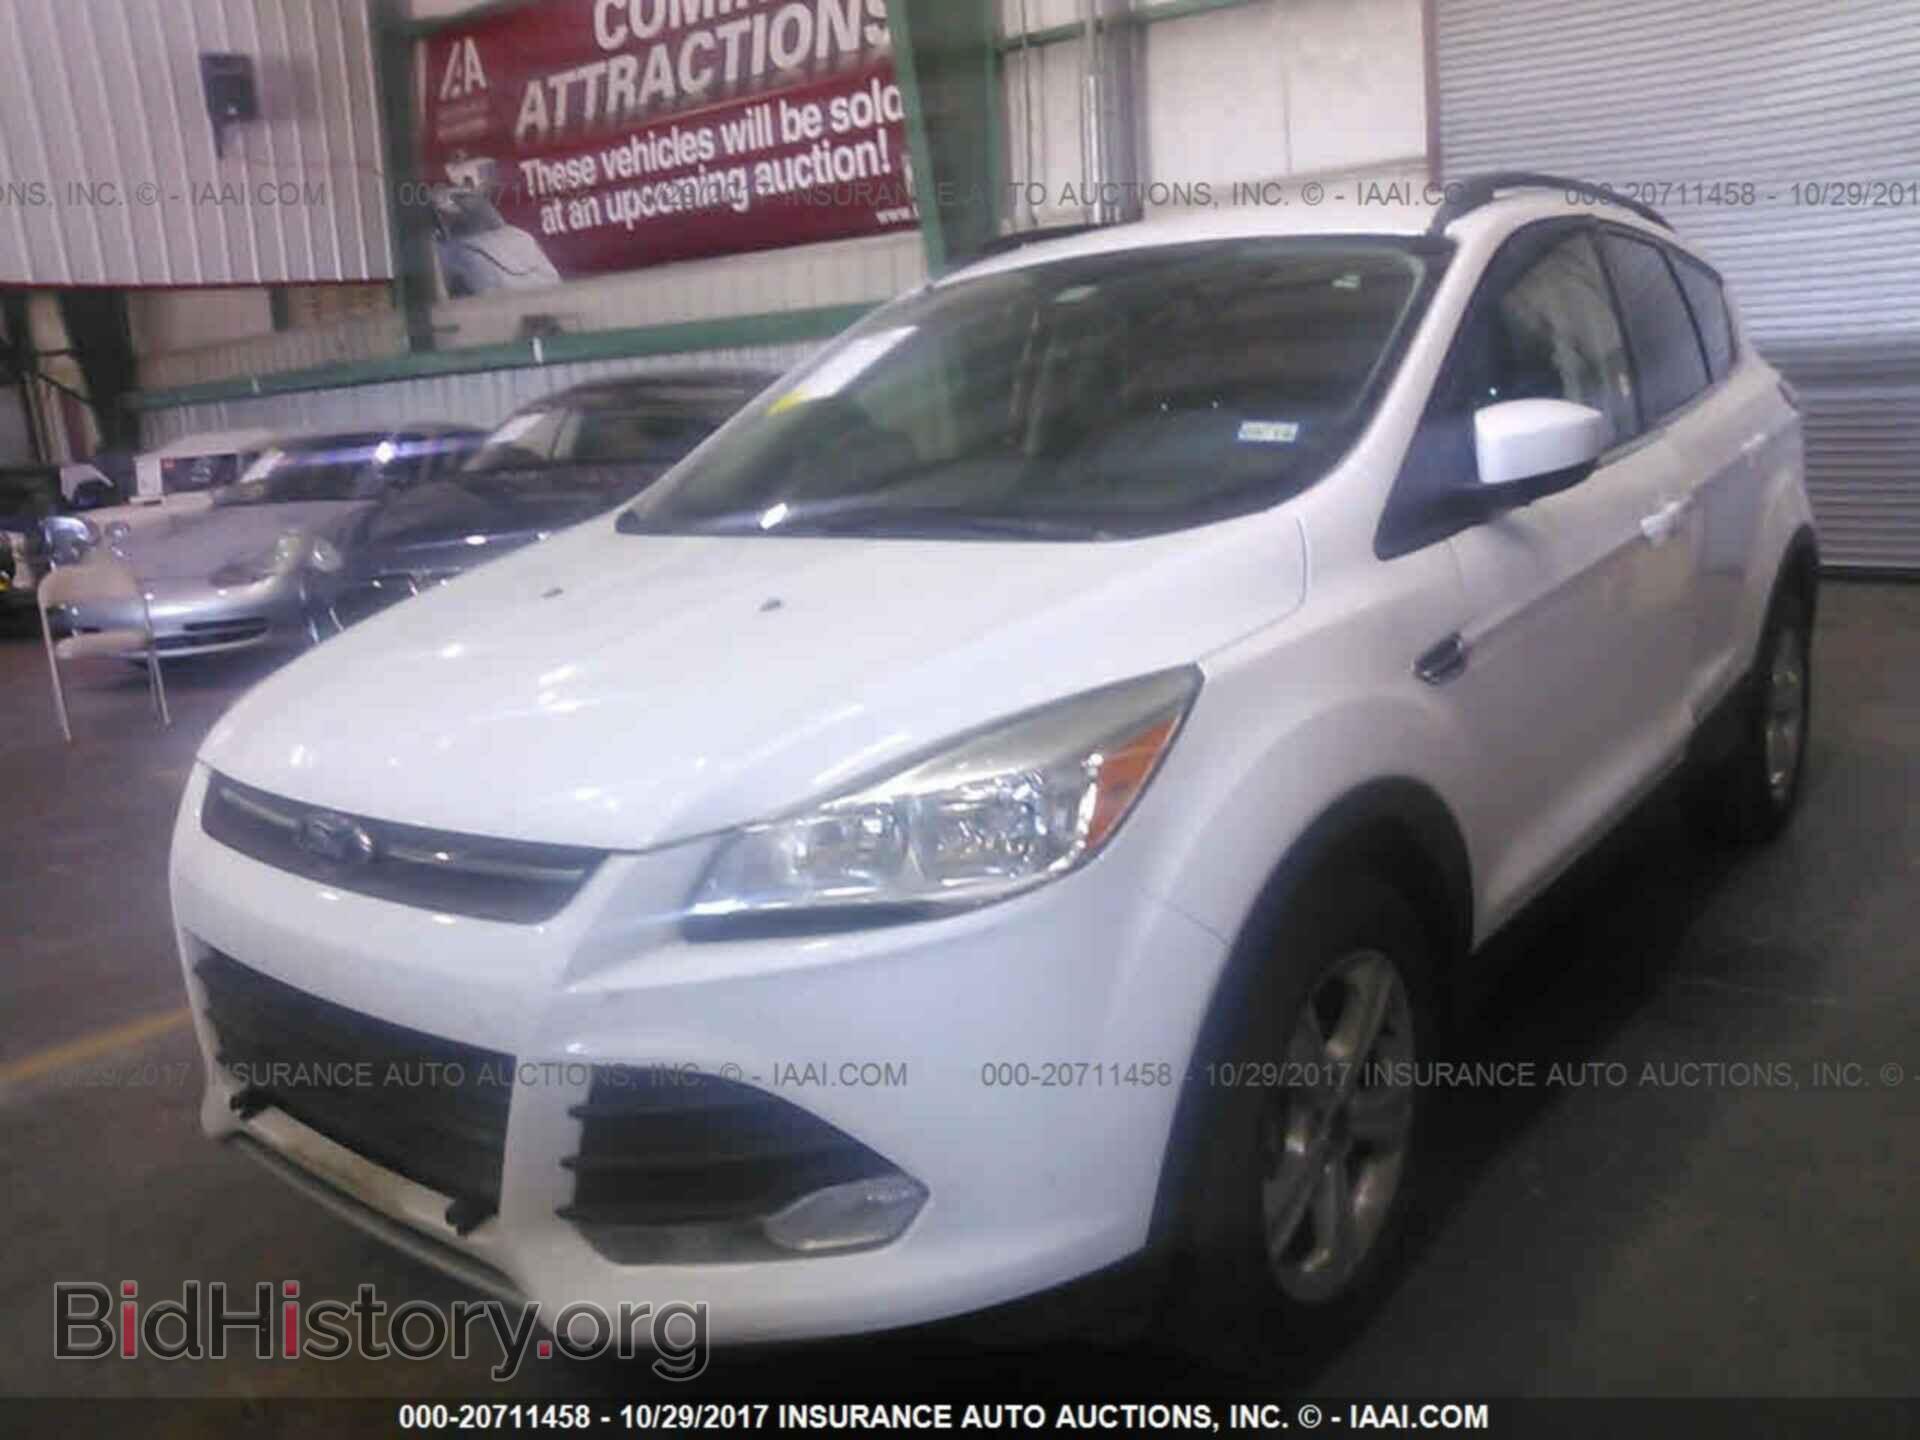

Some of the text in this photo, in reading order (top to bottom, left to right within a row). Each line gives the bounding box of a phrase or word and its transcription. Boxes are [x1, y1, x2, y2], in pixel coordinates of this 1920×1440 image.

[516, 0, 891, 138] ATTRACTIONS
[519, 154, 598, 198] These
[602, 126, 714, 181] vehicles
[720, 103, 773, 157] will
[781, 98, 823, 144] be
[830, 77, 905, 122] sold
[541, 203, 566, 236] at
[569, 198, 601, 231] an
[605, 163, 749, 231] upcoming
[757, 128, 892, 194] auction!
